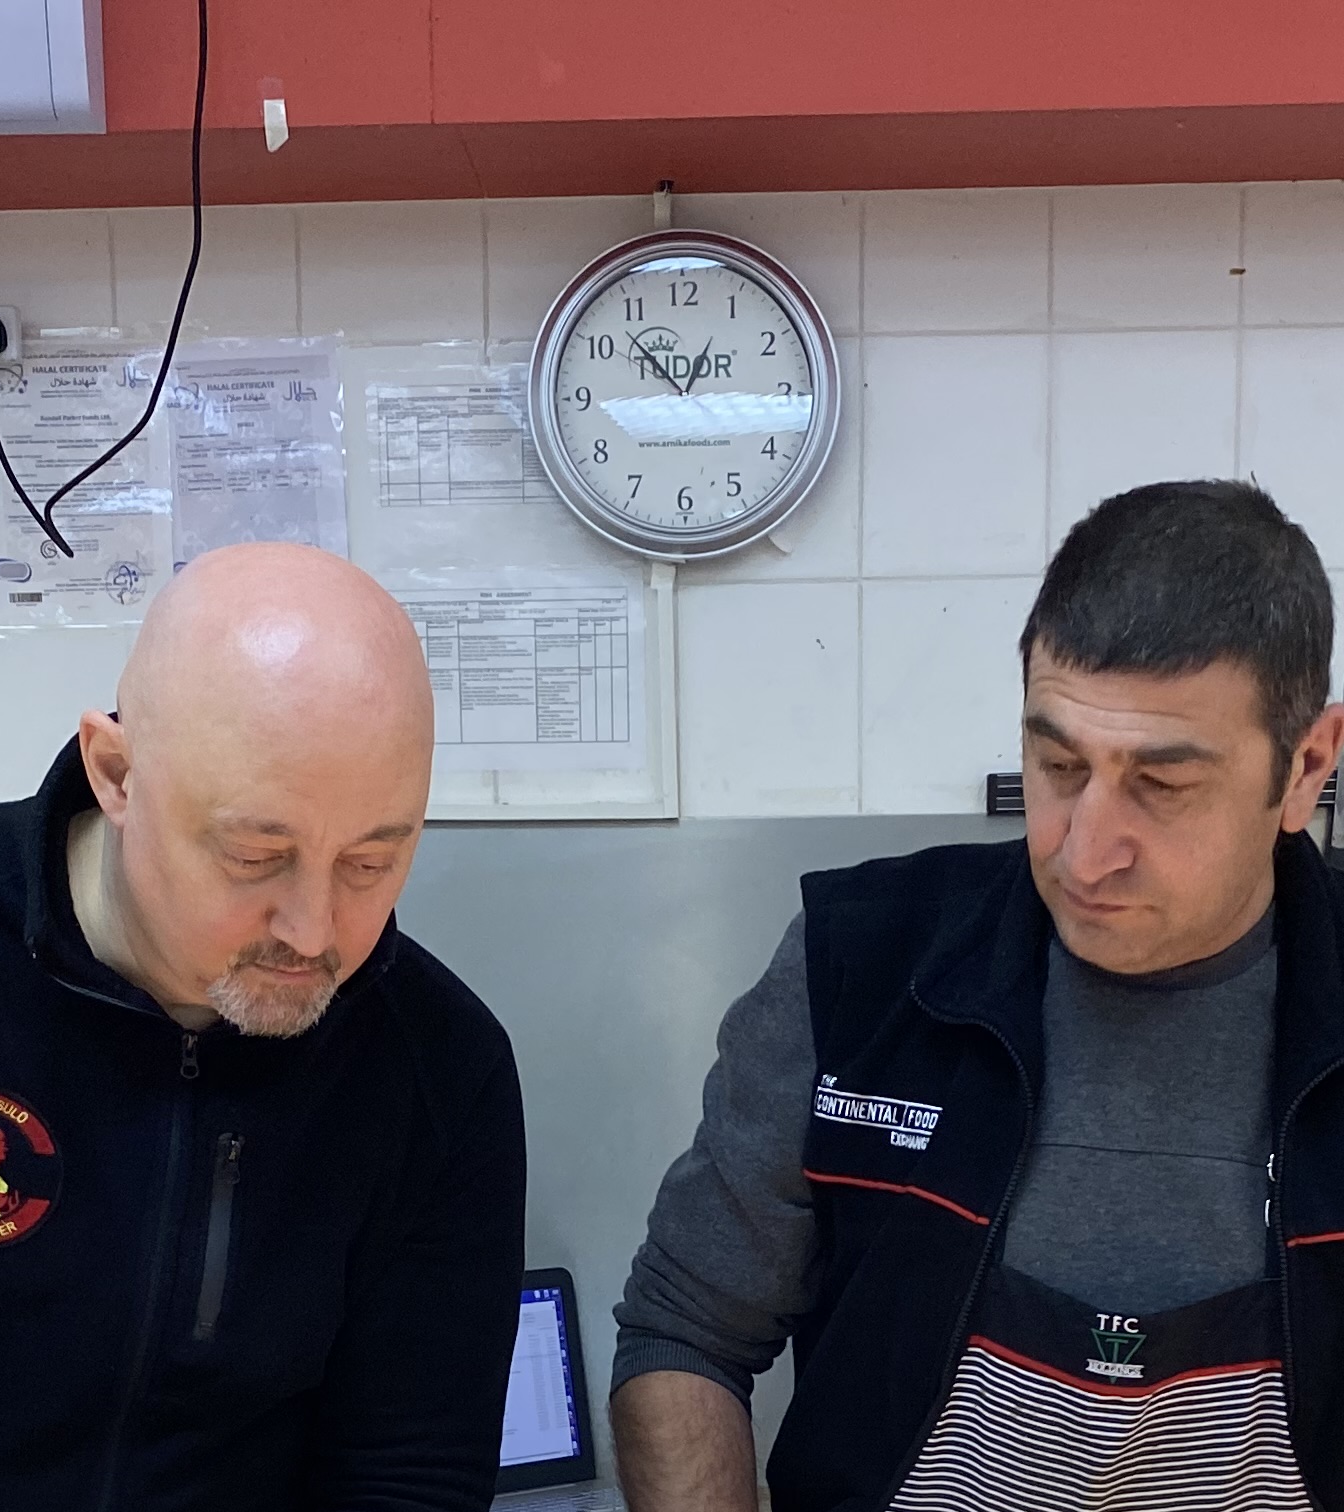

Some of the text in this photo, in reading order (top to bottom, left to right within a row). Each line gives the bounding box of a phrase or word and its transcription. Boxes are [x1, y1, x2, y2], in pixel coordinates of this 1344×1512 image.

[670, 281, 699, 307] 12
[624, 297, 644, 321] 11
[729, 295, 736, 319] 1
[587, 334, 614, 360] 10
[760, 331, 777, 357] 2
[32, 365, 107, 374] HALAL CERTIFICATE
[633, 353, 732, 380] TUDOR
[207, 383, 230, 391] HALAL
[575, 386, 591, 411] 9
[594, 439, 609, 464] 8
[760, 436, 778, 460] 4
[627, 474, 643, 499] 7
[726, 472, 742, 497] 5
[677, 486, 694, 512] 6
[816, 1094, 939, 1130] CONTINENTAL FOOD
[1096, 1313, 1139, 1333] TFC
